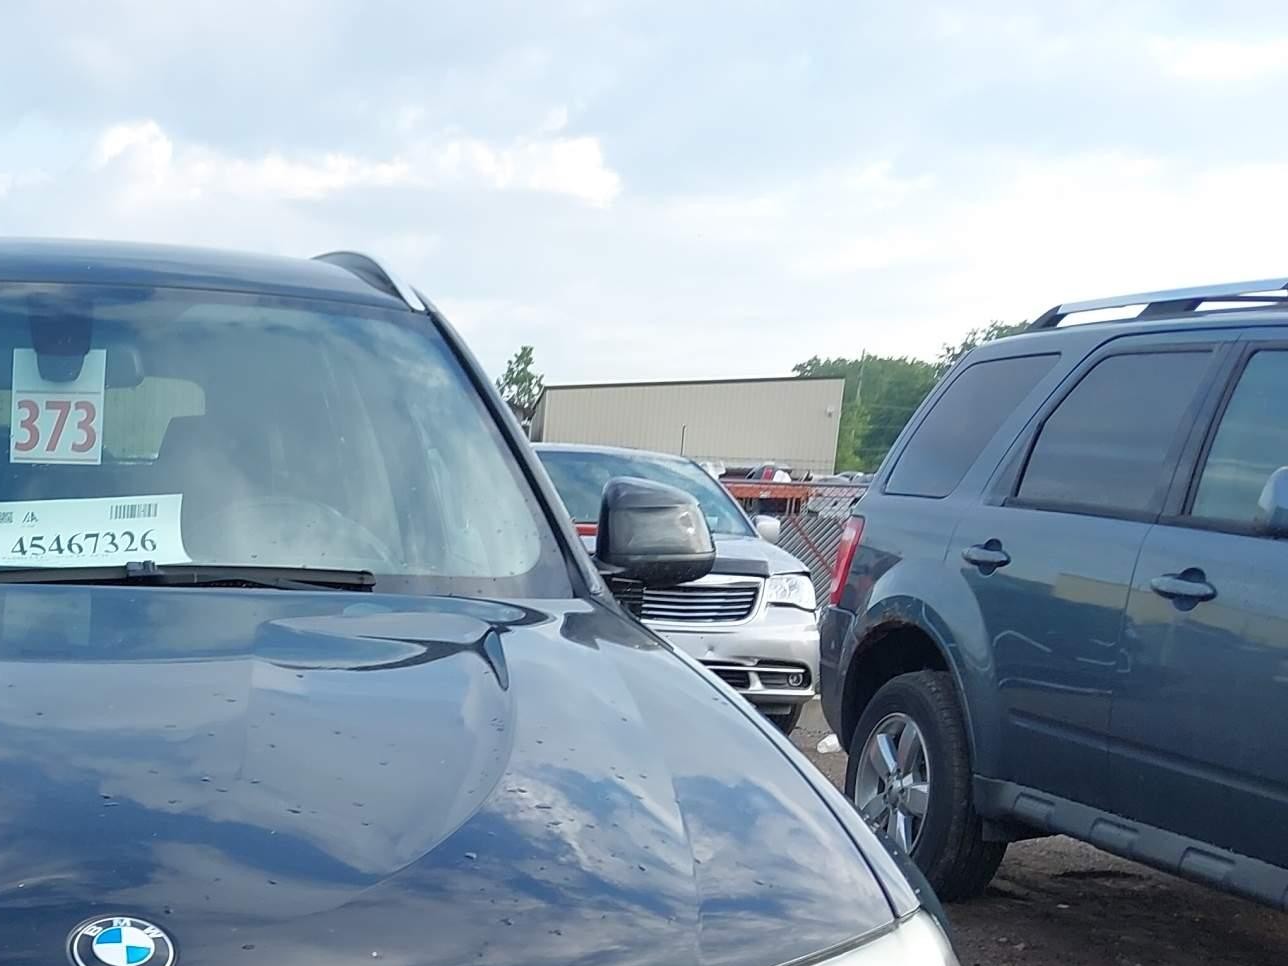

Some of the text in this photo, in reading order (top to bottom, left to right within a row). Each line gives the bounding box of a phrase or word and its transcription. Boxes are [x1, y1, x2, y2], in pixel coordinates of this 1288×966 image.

[14, 399, 97, 453] 373
[10, 529, 158, 557] 45467326
[82, 918, 165, 939] BMW
